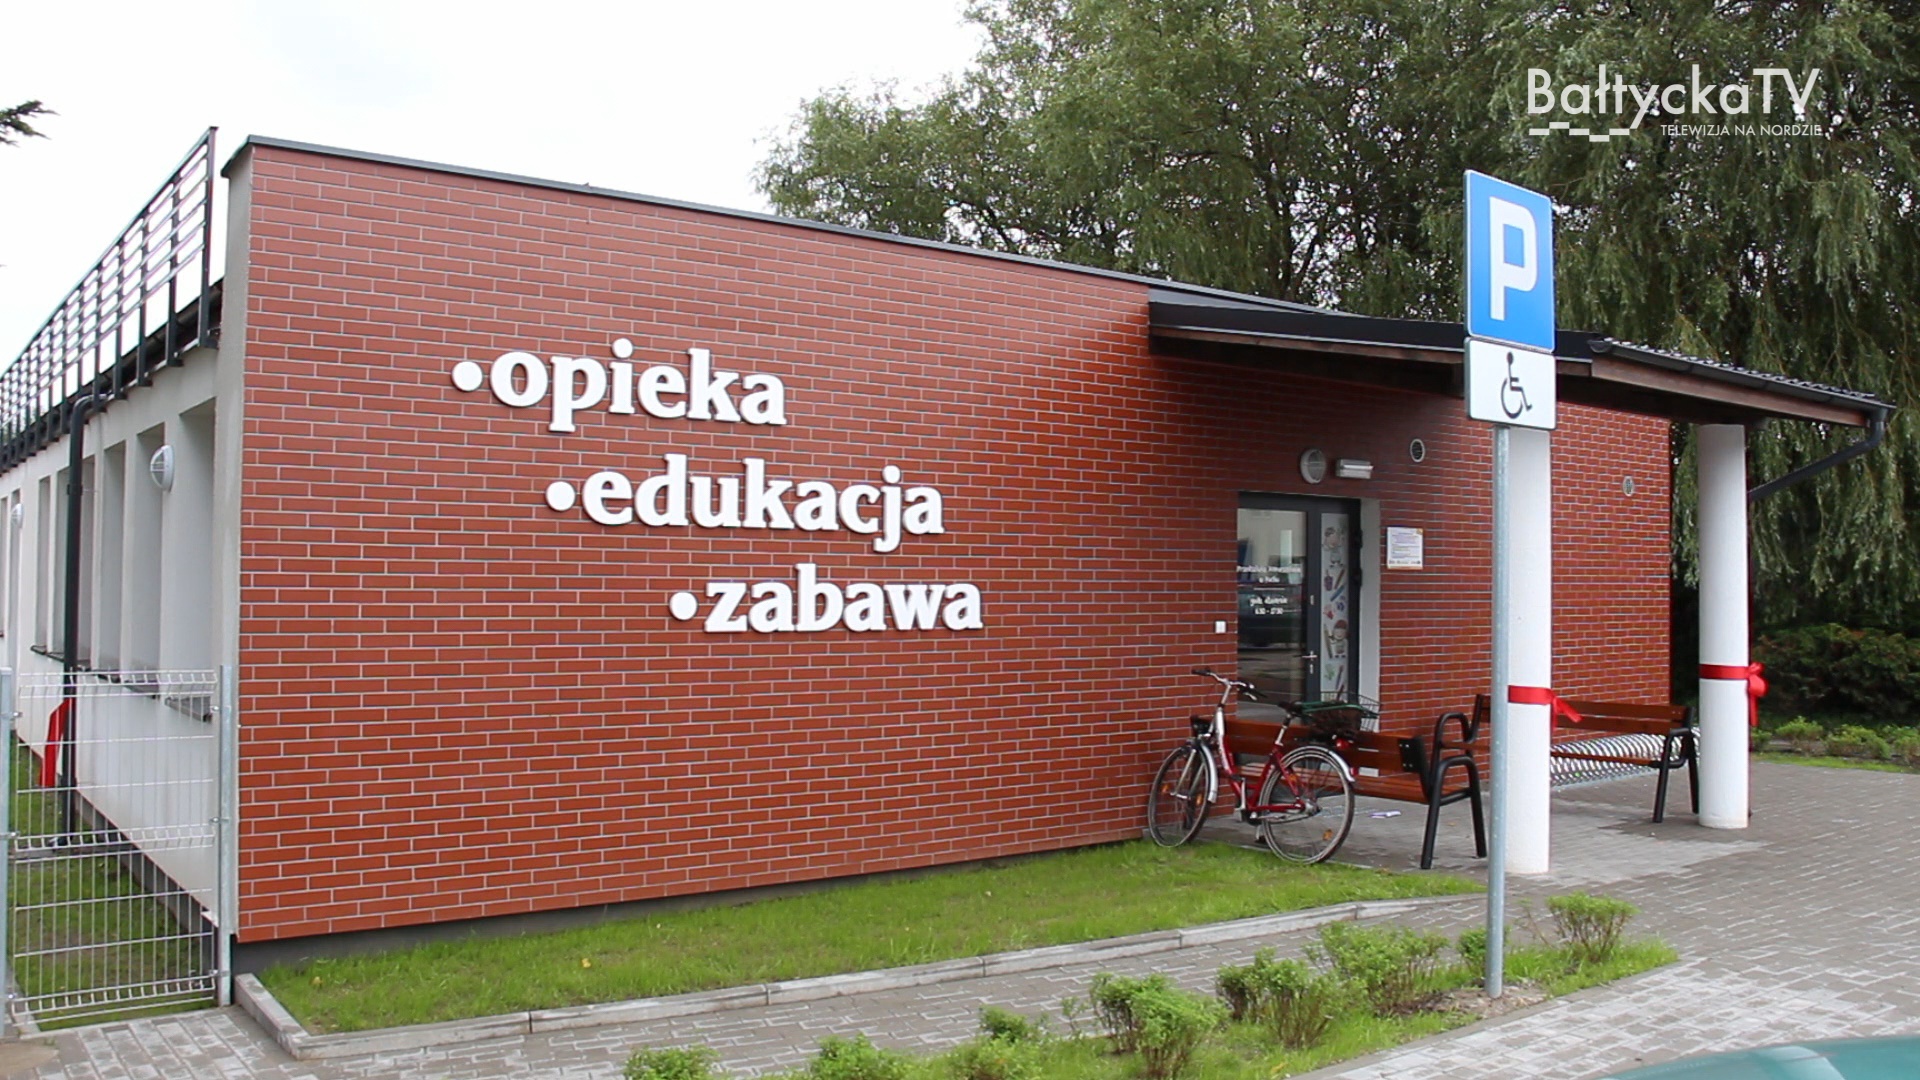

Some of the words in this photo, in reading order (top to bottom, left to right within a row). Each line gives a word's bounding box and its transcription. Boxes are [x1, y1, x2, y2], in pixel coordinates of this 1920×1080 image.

[1489, 196, 1538, 321] P
[490, 338, 787, 432] opieka
[582, 454, 945, 552] edukacja
[704, 563, 983, 633] zabawa
